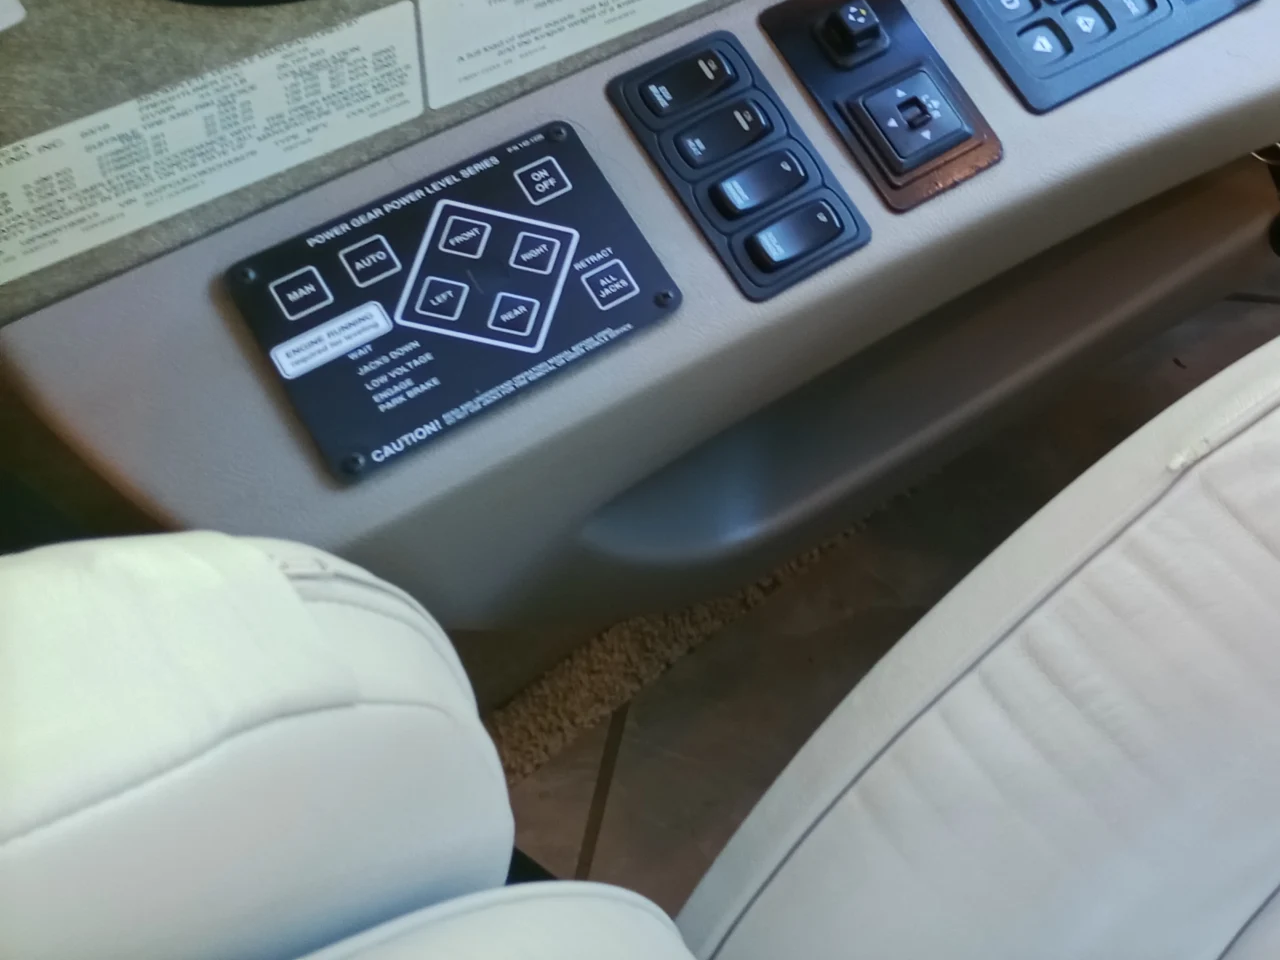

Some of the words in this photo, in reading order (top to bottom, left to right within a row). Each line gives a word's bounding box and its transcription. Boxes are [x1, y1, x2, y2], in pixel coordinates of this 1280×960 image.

[530, 167, 548, 183] ON
[534, 175, 557, 193] OFF
[306, 221, 351, 248] POWER
[351, 206, 384, 228] GEAR
[382, 188, 425, 214] POWER
[424, 172, 460, 195] LEVEL
[459, 154, 500, 179] SERIES
[448, 225, 481, 248] FRONT
[352, 249, 387, 273] AUTO
[520, 242, 549, 262] RIGHT
[573, 246, 613, 271] RETRACT
[597, 277, 629, 299] JACKS
[598, 272, 617, 287] ALL
[286, 281, 317, 304] MAN
[428, 288, 454, 307] LEFT
[499, 303, 527, 323] REAR
[347, 343, 373, 362] WAIT
[355, 354, 389, 377] JACKS
[388, 339, 421, 361] DOWN
[364, 374, 388, 391] LOW
[388, 350, 434, 379] VOLTAGE
[373, 377, 414, 404] ENGAGE
[378, 393, 406, 413] PARK
[406, 375, 440, 399] BRAKE
[370, 418, 443, 464] CAUTION!
